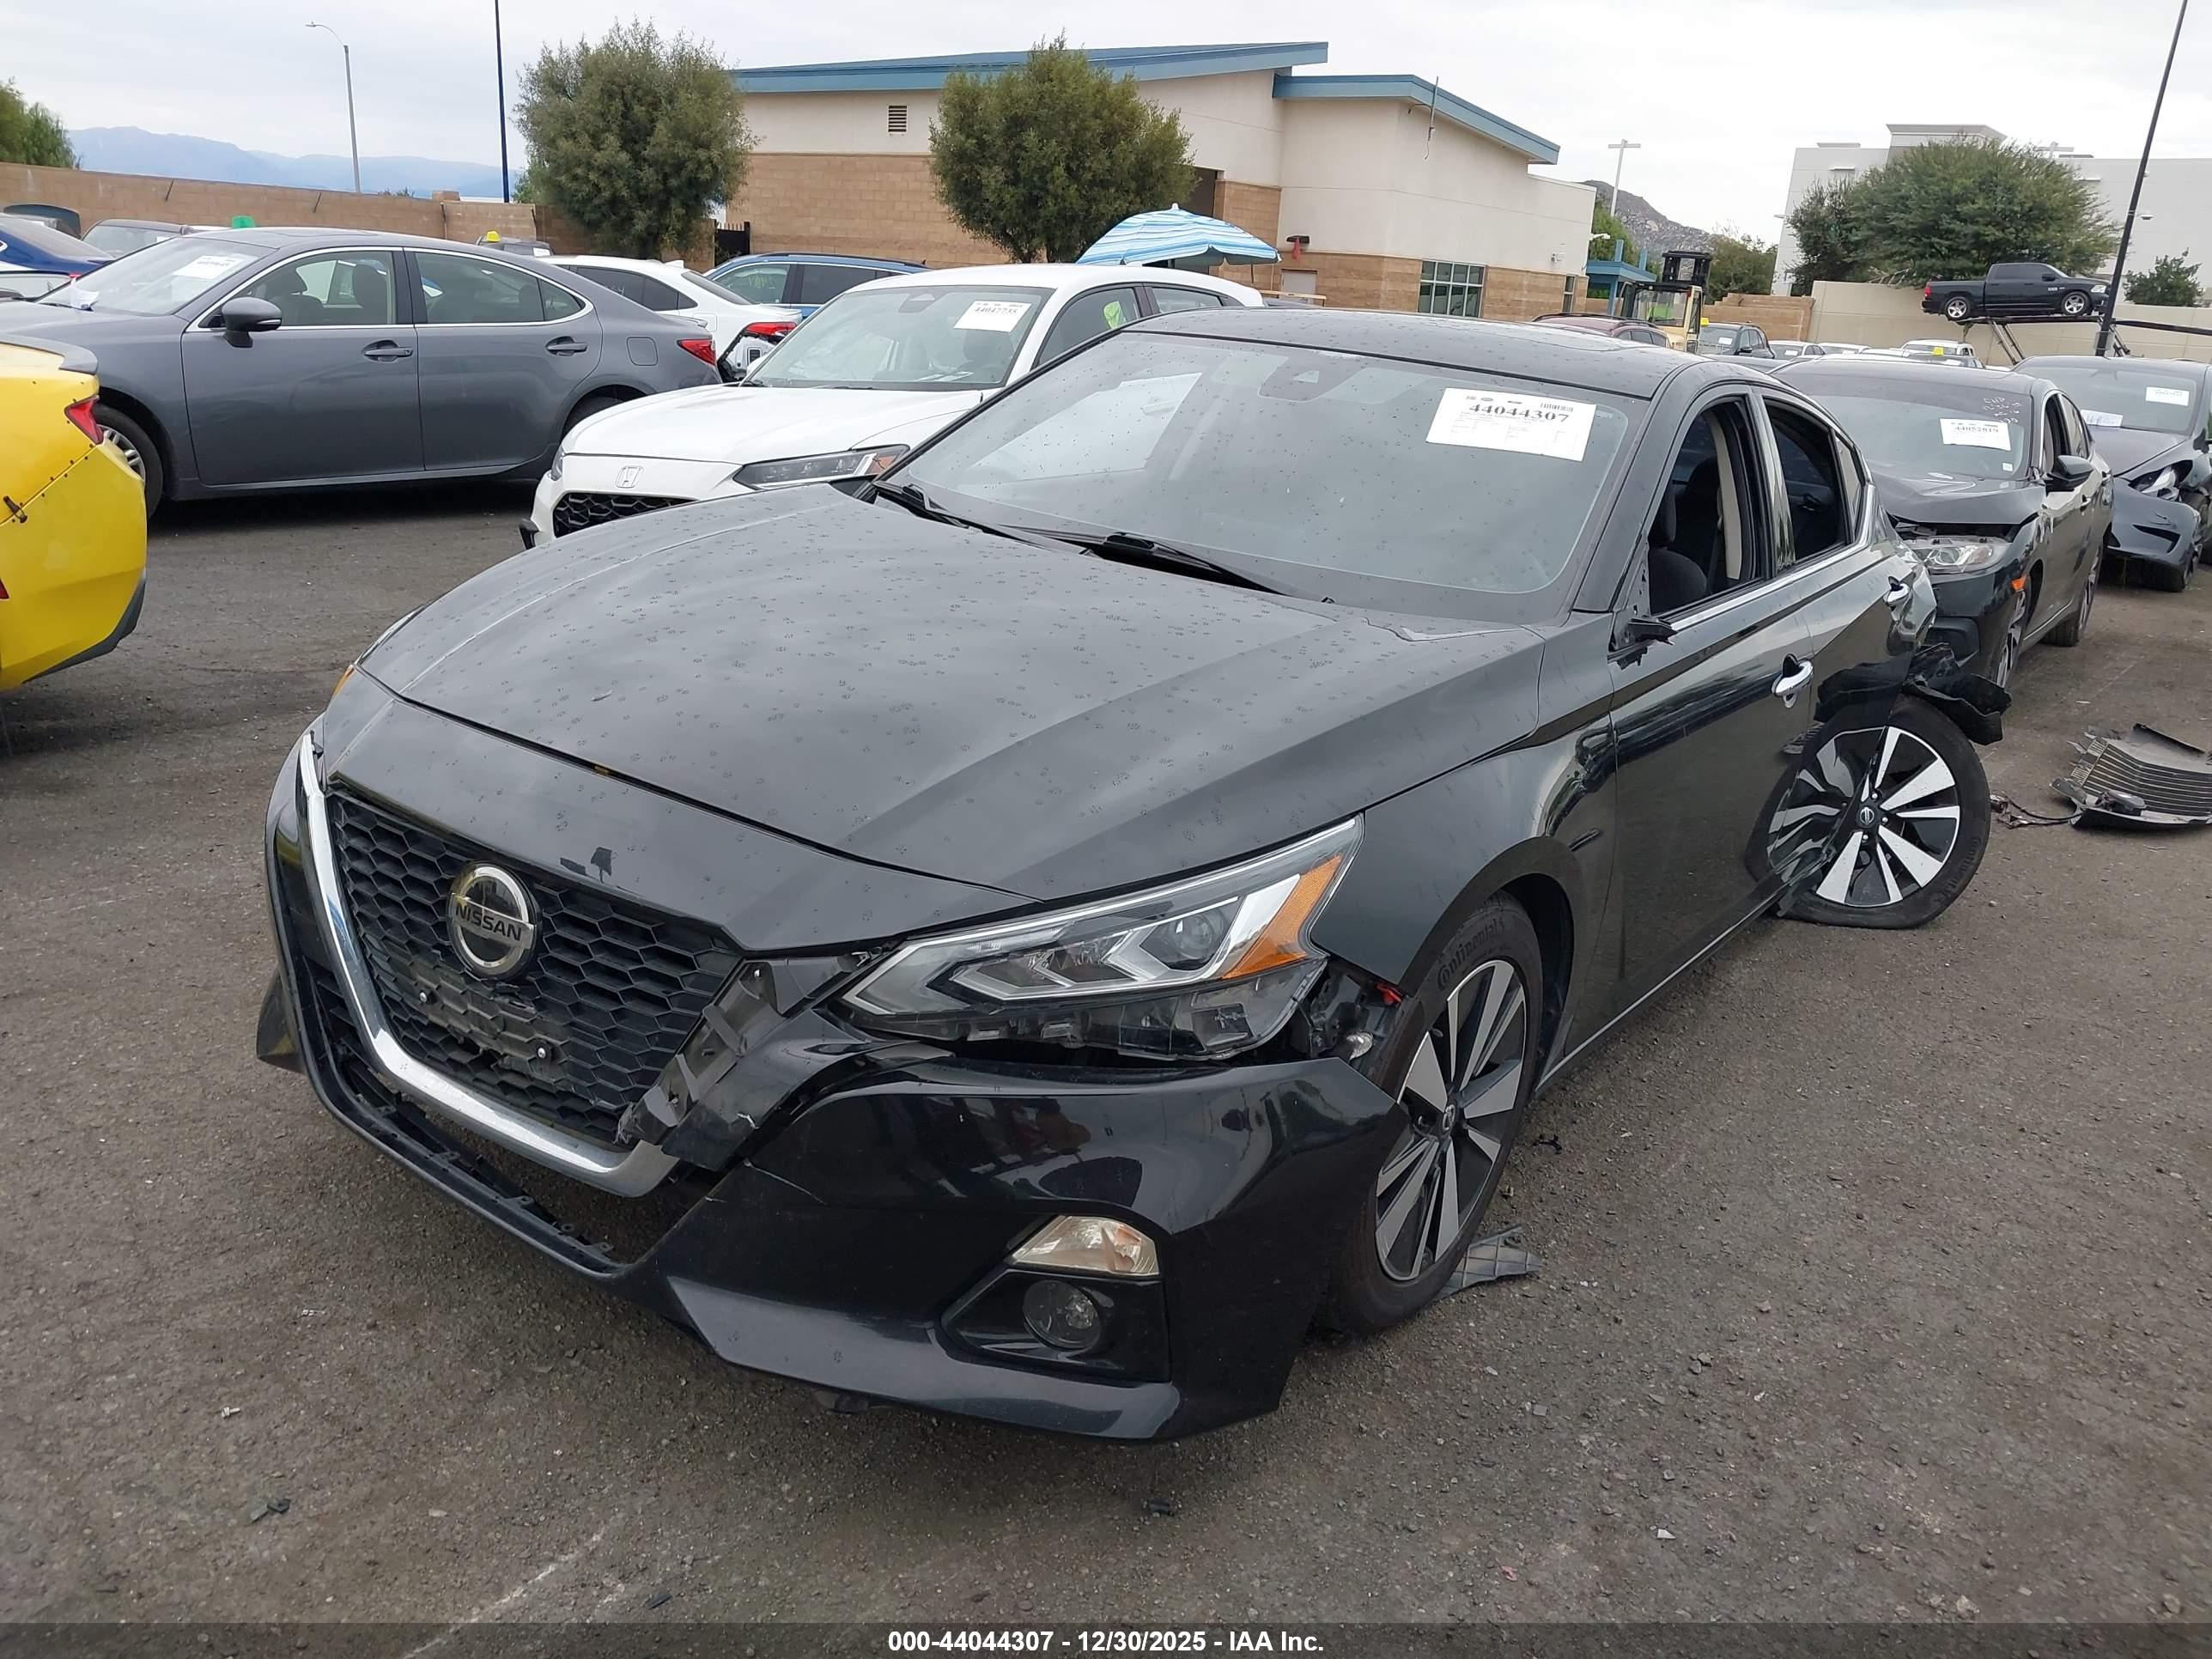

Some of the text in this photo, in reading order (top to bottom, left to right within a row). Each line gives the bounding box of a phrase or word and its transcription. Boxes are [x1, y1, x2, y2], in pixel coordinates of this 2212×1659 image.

[1469, 404, 1570, 422] 44044307
[455, 905, 522, 942] NISSAN
[1437, 918, 1498, 991] Continental
